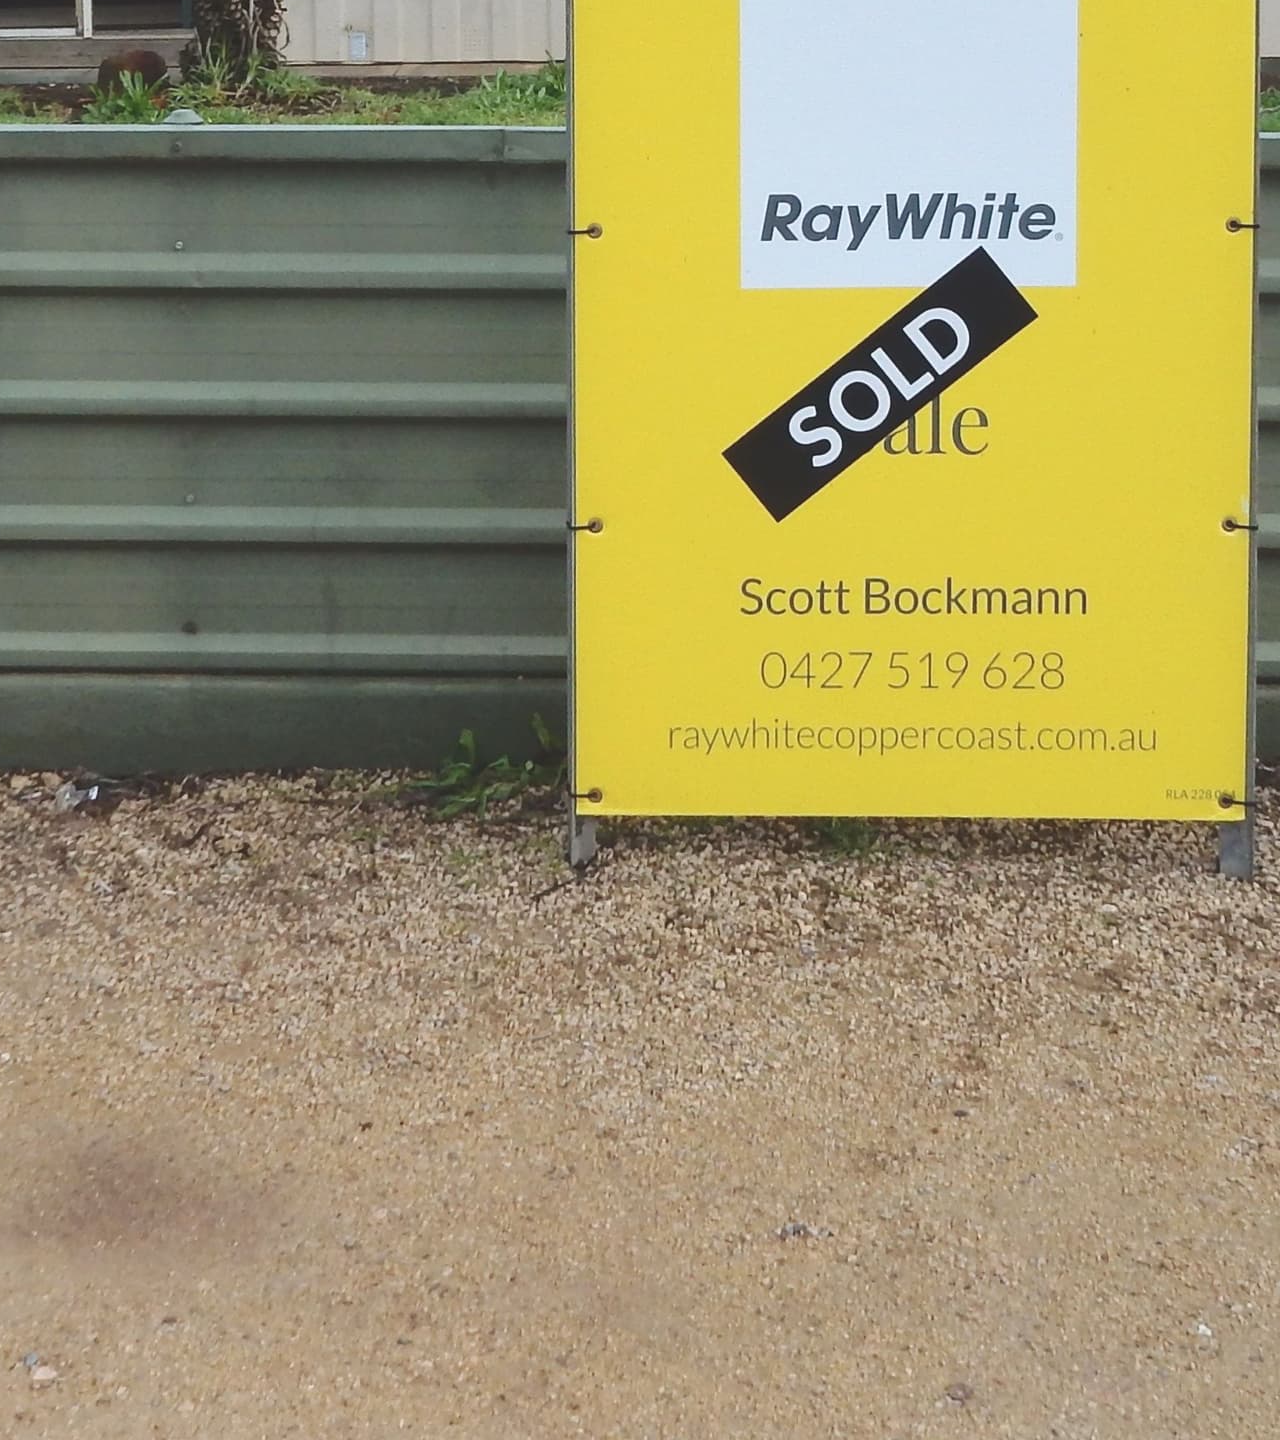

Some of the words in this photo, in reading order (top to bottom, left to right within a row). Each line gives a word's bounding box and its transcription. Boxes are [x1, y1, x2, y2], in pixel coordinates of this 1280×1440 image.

[760, 192, 1056, 251] RayWhite
[788, 306, 971, 467] SOLD
[882, 393, 990, 456] ale
[739, 577, 851, 616] Scott
[864, 576, 1088, 616] Bockmann
[760, 651, 873, 690] 0427
[887, 651, 969, 690] 519
[982, 651, 1066, 690] 628
[668, 717, 1158, 757] raywhitecoppercoast.com.au
[1165, 788, 1189, 800] RLA
[1191, 788, 1213, 800] 228
